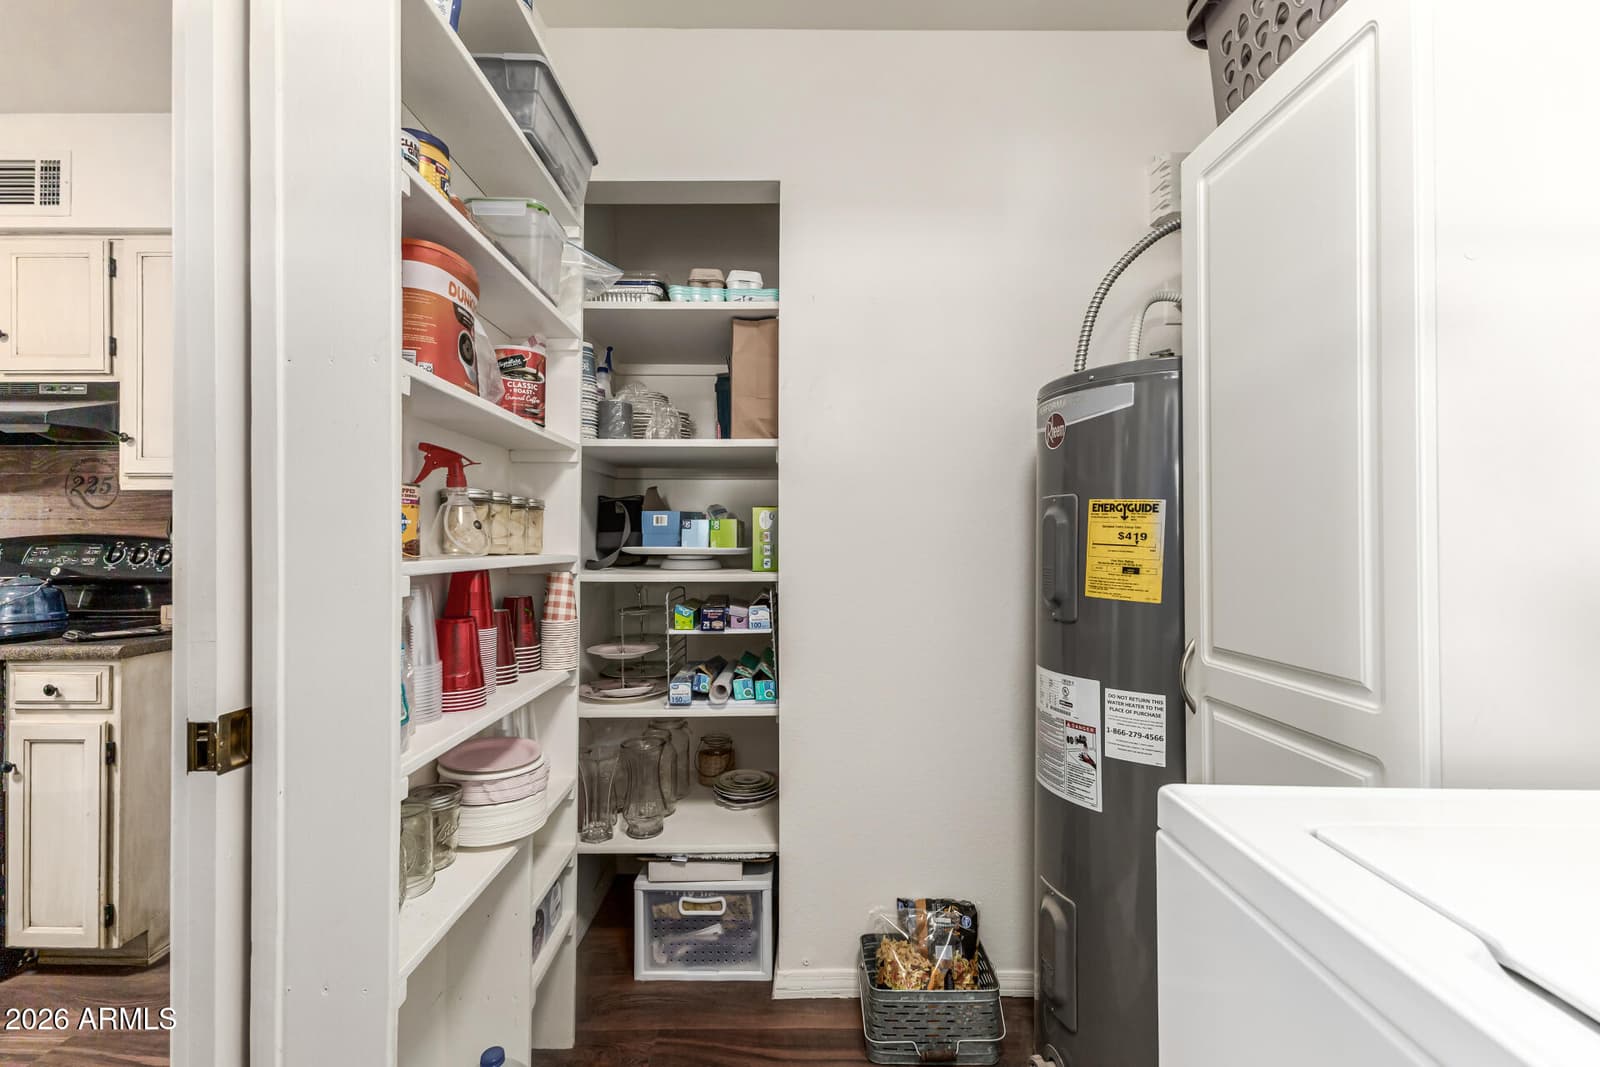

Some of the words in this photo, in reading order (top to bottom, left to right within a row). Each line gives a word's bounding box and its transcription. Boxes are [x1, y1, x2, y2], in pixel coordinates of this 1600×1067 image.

[507, 381, 539, 391] CLASSIC
[1047, 415, 1065, 443] Rheem
[70, 475, 113, 495] 225
[1092, 503, 1159, 513] ENERGYGUIDE
[1117, 531, 1147, 541] $419
